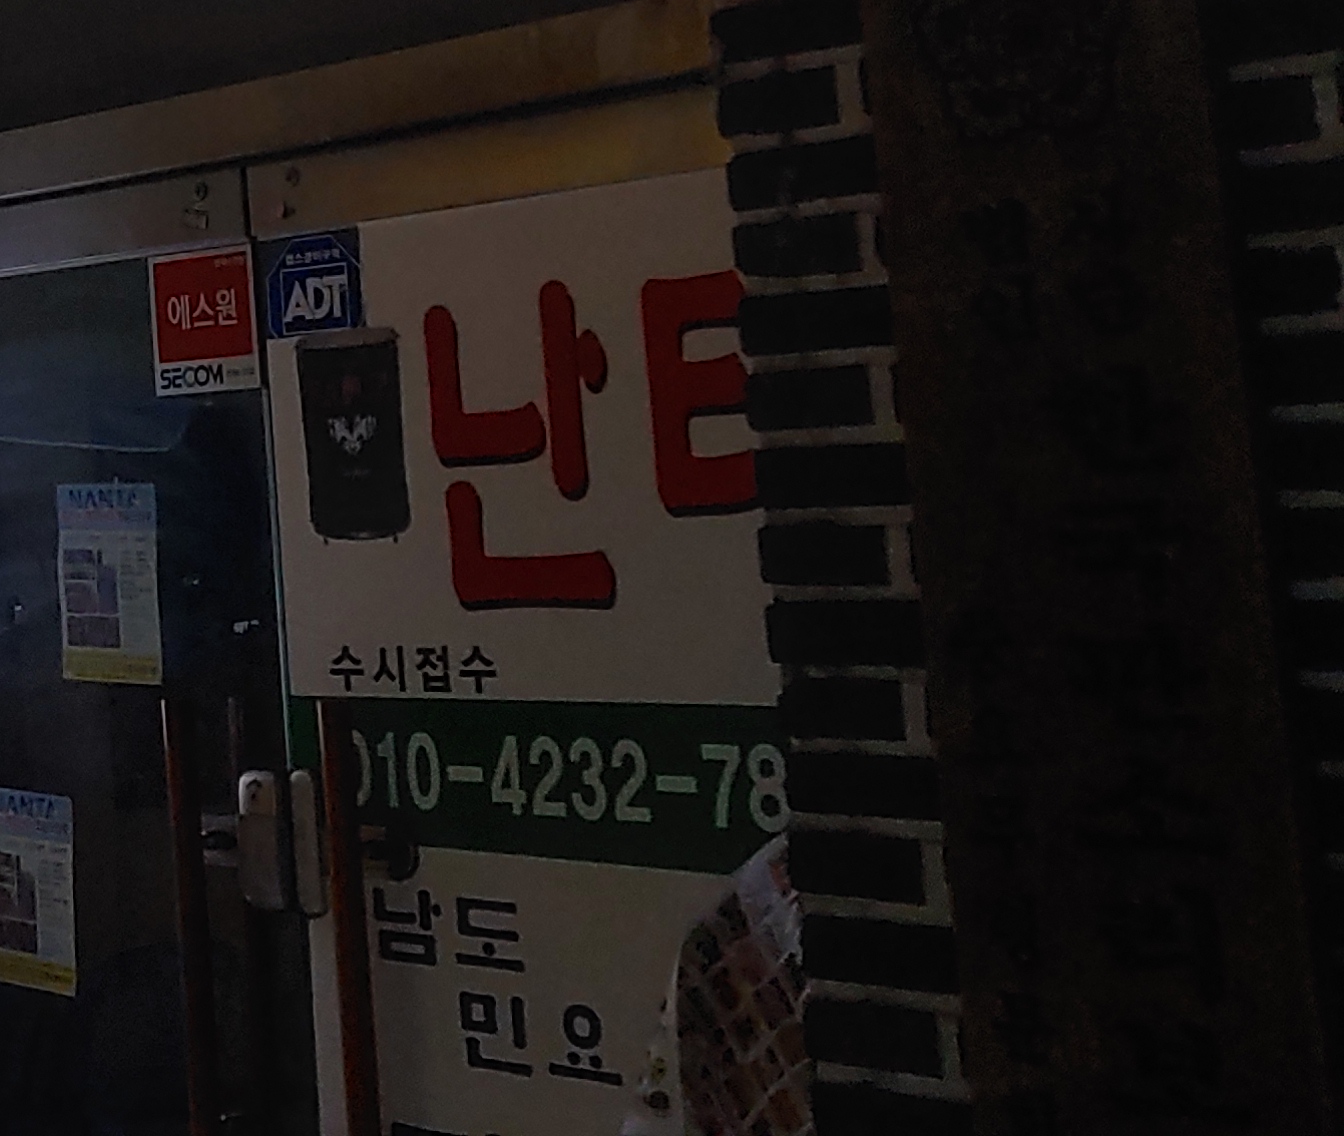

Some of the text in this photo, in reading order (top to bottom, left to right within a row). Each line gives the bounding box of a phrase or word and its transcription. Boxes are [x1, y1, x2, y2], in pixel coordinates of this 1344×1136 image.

[167, 288, 239, 331] 에스원
[284, 274, 347, 323] ADT
[160, 364, 224, 389] SECOM
[329, 645, 497, 693] 수시접수
